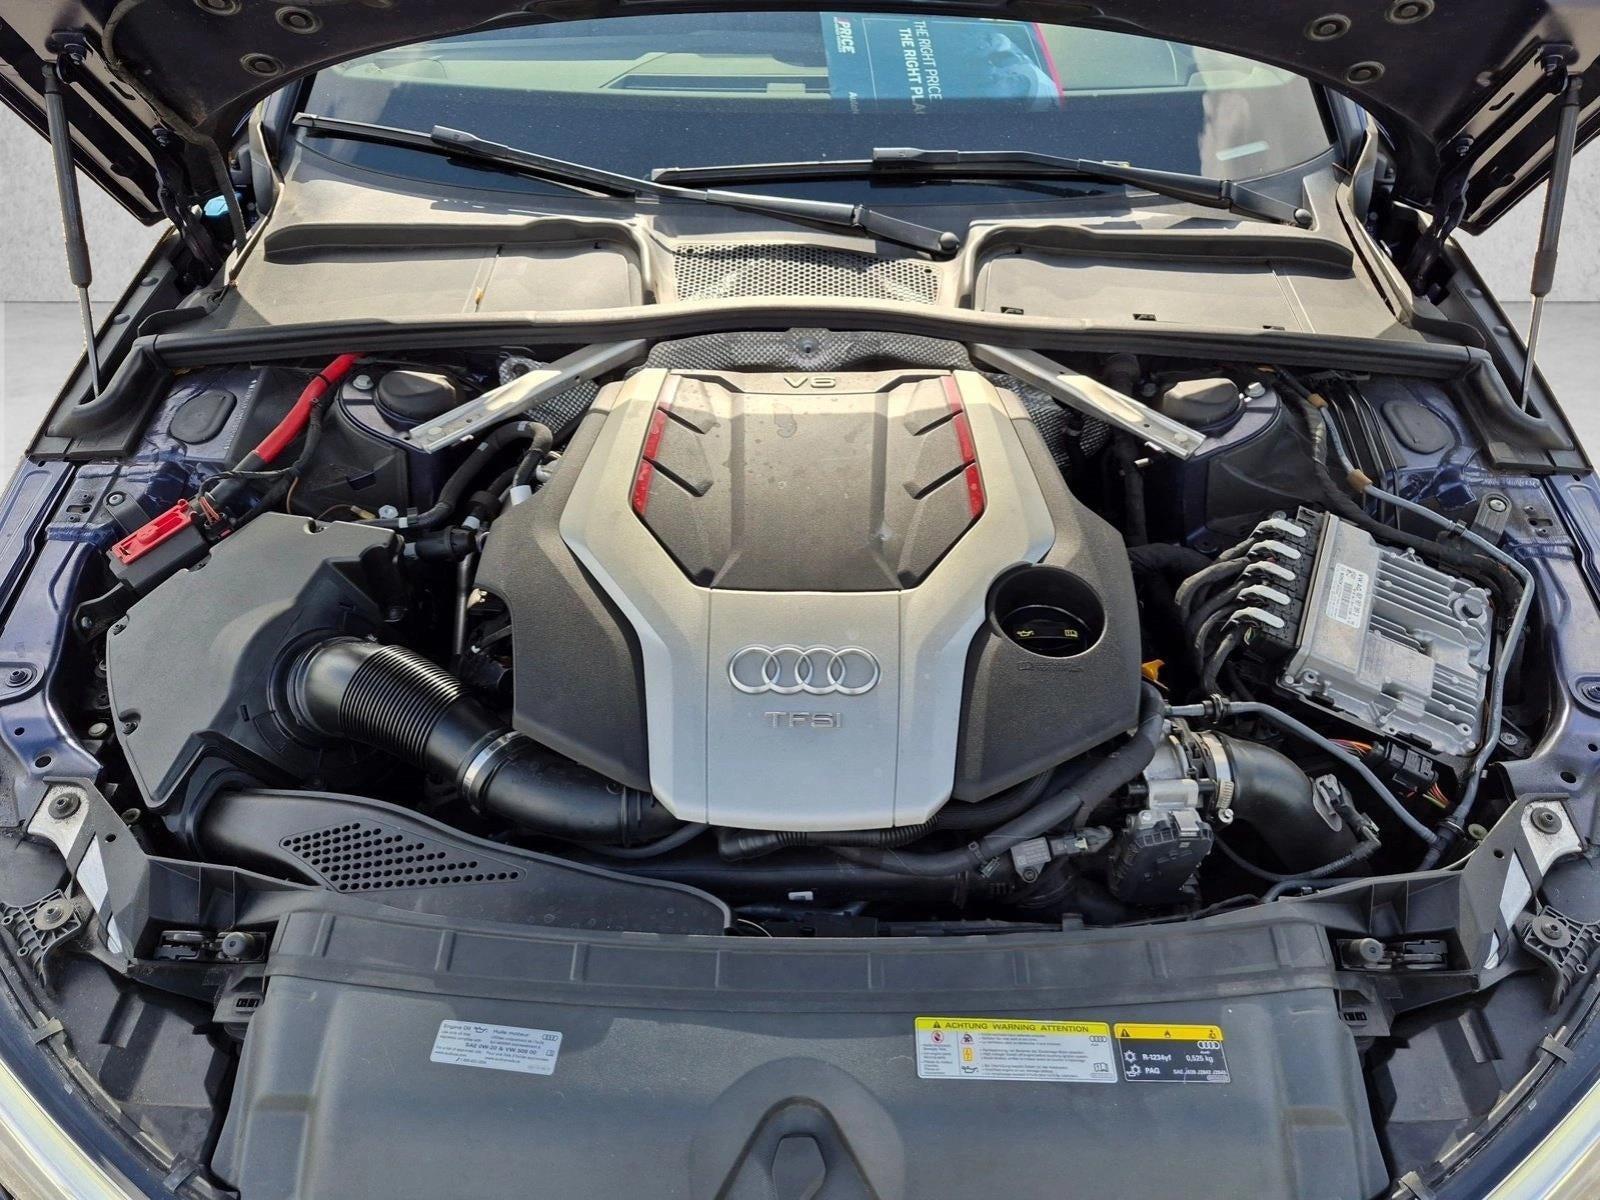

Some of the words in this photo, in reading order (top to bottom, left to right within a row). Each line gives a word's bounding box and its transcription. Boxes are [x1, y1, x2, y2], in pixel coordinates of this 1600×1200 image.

[899, 27, 915, 48] THE
[913, 20, 929, 38] THE
[918, 38, 937, 68] RIGHT
[904, 49, 922, 84] RIGHT
[925, 68, 943, 102] PRICE
[765, 711, 841, 729] TFSI
[945, 1022, 988, 1030] ACHTUNG
[992, 1023, 1036, 1031] WARNING
[1040, 1025, 1089, 1033] ATTENTION
[1205, 1055, 1214, 1064] kg
